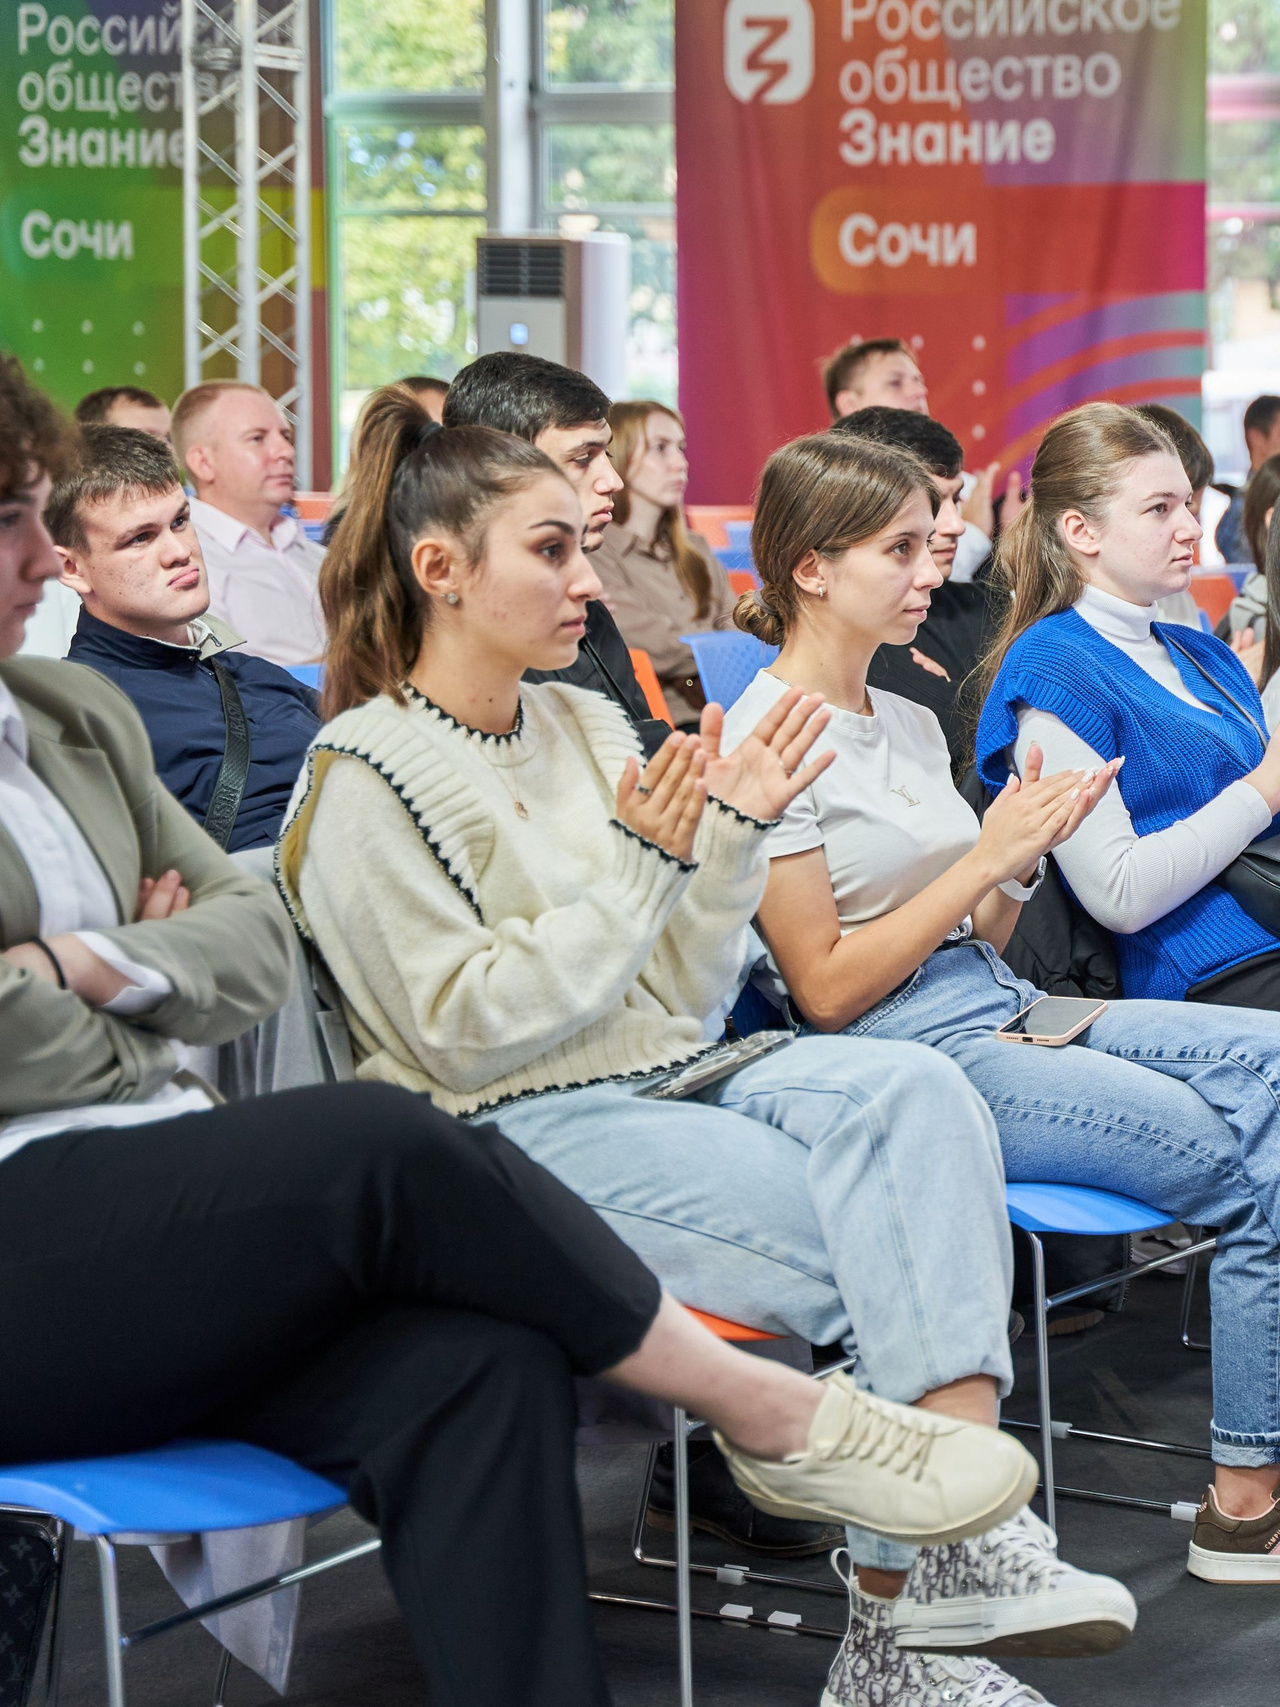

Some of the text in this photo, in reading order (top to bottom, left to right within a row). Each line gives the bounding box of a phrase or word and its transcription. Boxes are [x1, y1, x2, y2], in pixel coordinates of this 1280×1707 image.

[839, 48, 1122, 110] общество
[839, 108, 1057, 166] Знание
[20, 210, 134, 260] Сочи
[838, 213, 977, 266] Сочи
